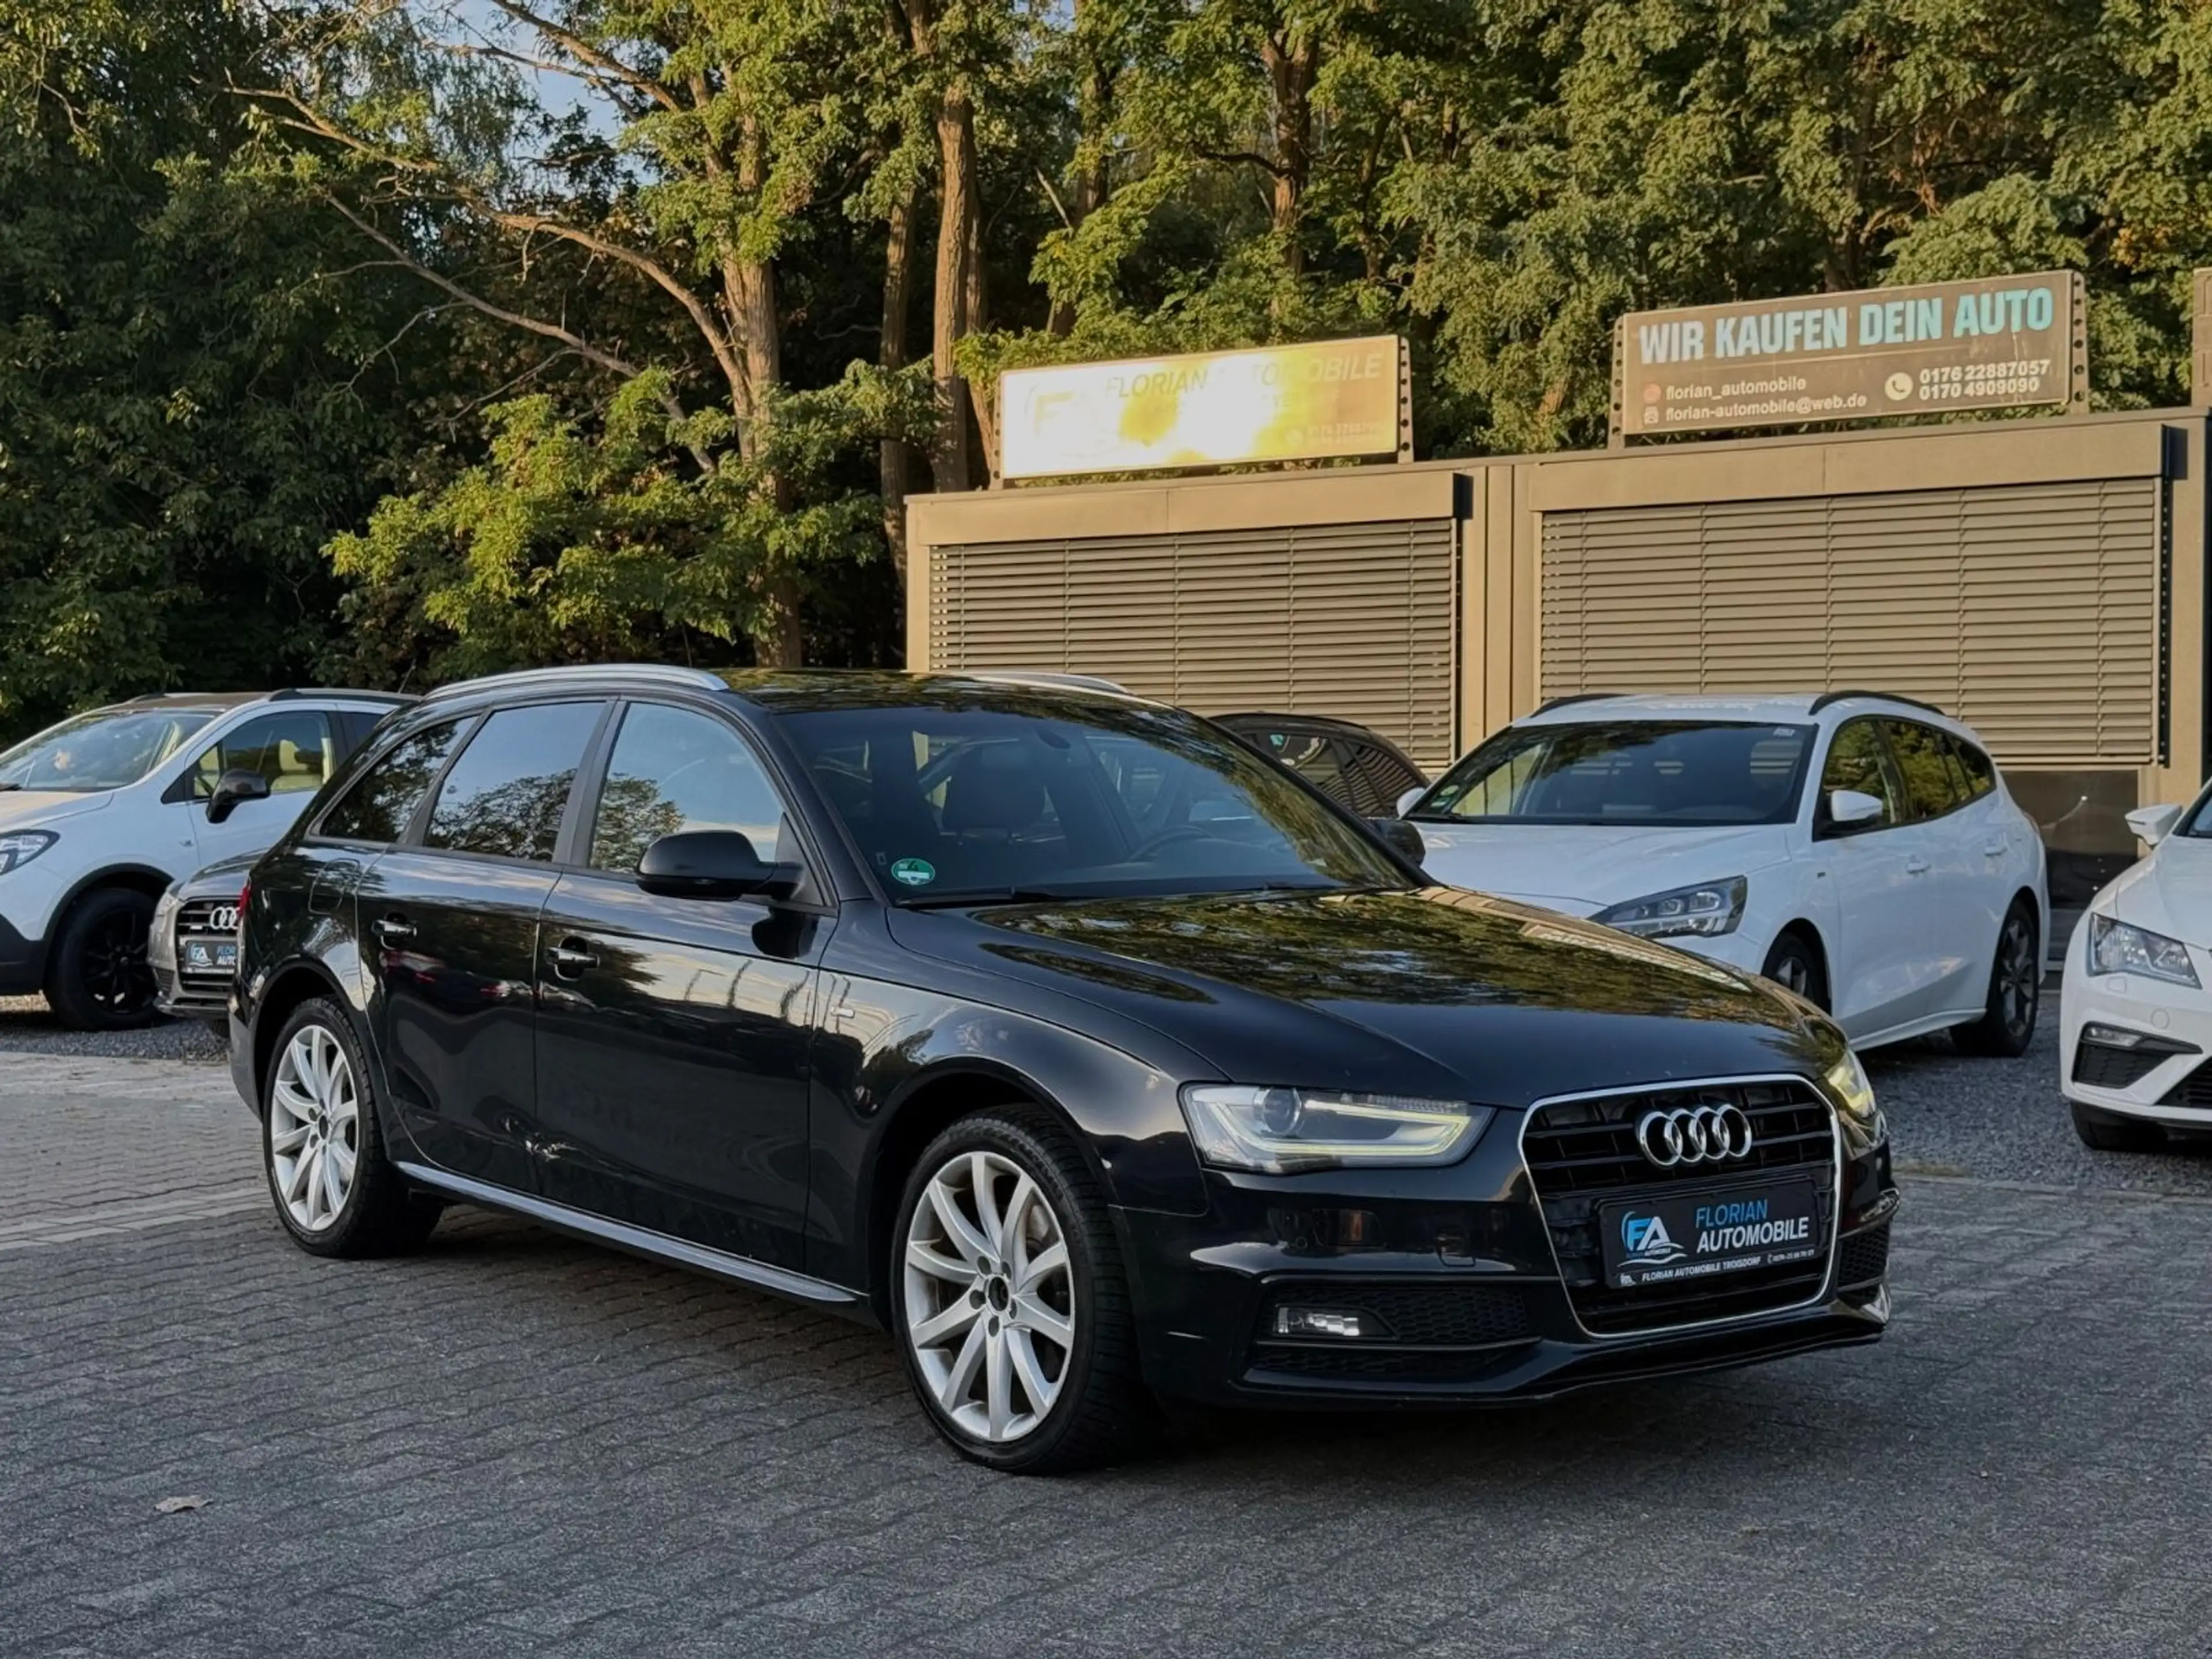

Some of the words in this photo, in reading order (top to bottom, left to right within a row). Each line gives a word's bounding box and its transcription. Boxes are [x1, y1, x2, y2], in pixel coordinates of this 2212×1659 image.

[1639, 320, 1704, 364] WIR
[1715, 306, 1848, 359] KAUFEN
[1859, 297, 1942, 346] DEIN
[1953, 287, 2053, 339] AUTO
[1105, 369, 1209, 399] FLORIAN
[1919, 365, 1963, 384] 0176
[1964, 359, 2051, 381] 22887057
[1665, 376, 1806, 400] florian_automobile
[1919, 382, 1962, 401] 0170
[1964, 376, 2040, 397] 4909090
[1665, 392, 1867, 422] florian-automobile@web.de
[1695, 1198, 1768, 1229] FLORIAN
[1627, 1215, 1671, 1252] FA
[1696, 1216, 1809, 1254] AUTOMOBILE
